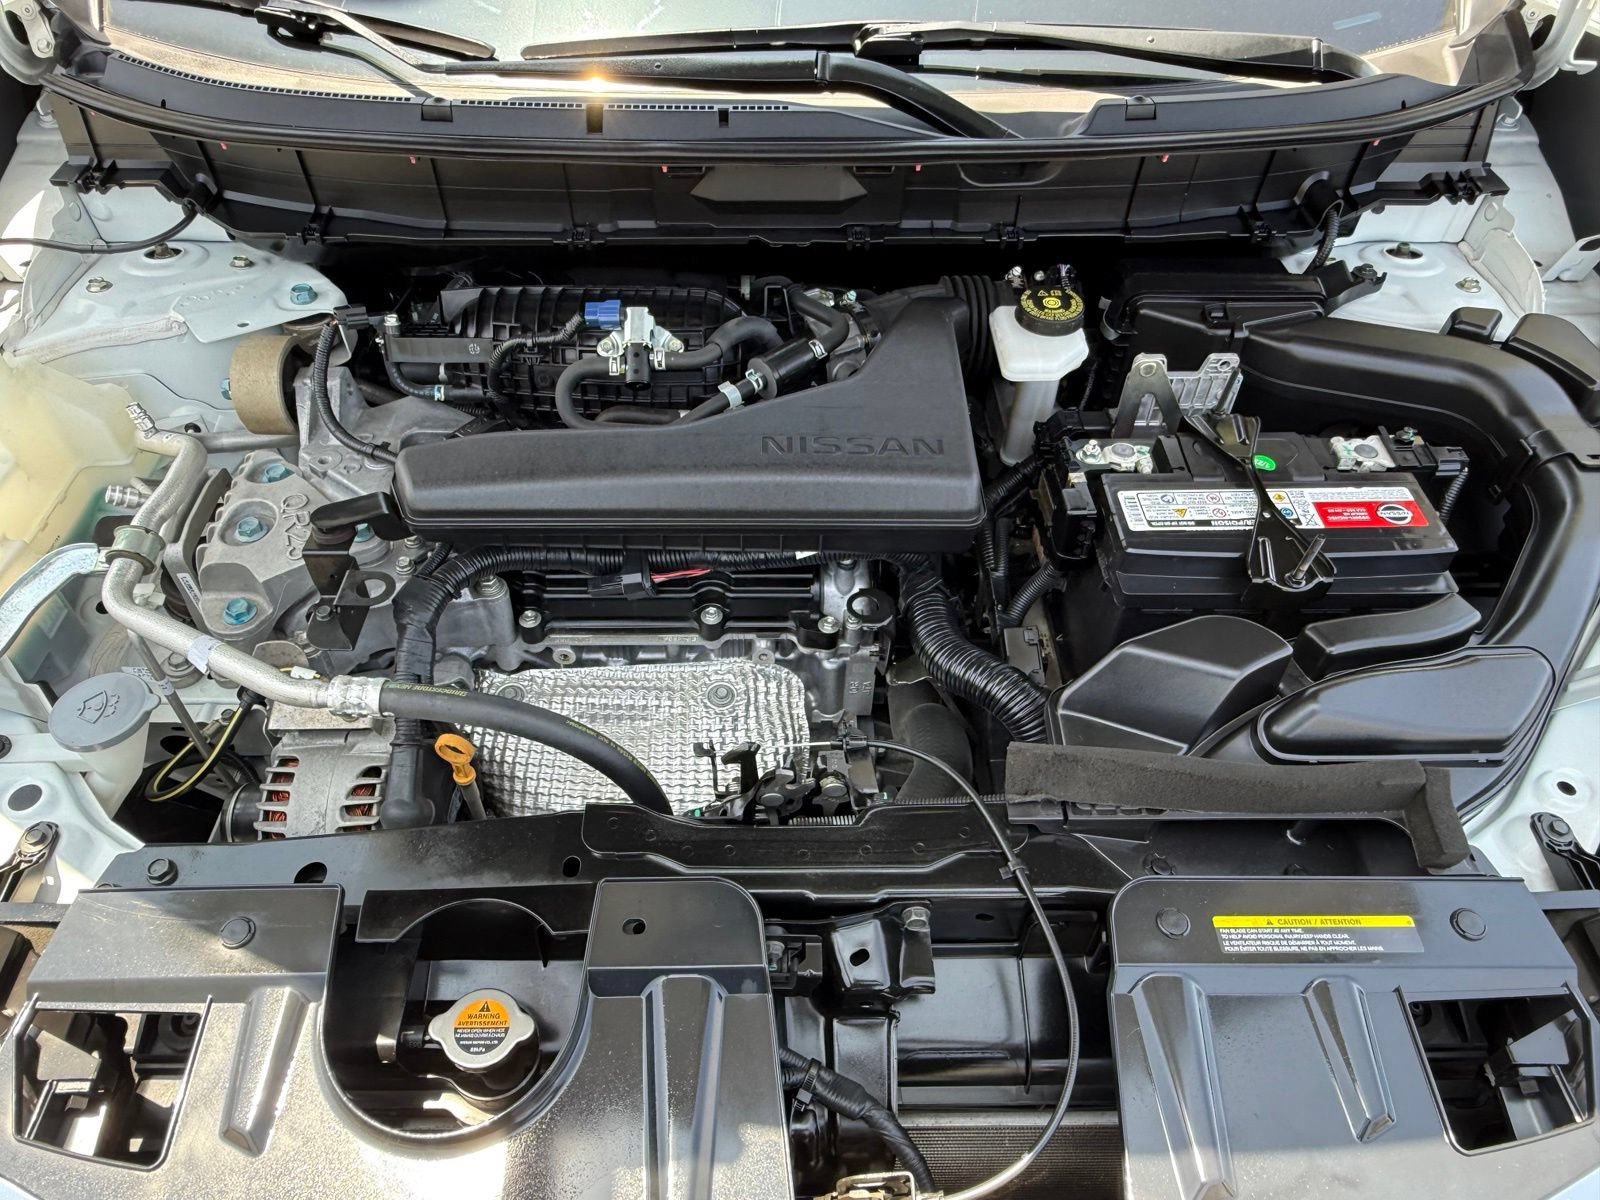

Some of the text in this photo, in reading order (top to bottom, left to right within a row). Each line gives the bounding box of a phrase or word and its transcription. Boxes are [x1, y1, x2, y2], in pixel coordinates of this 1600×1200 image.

[761, 436, 945, 456] NISSAN
[1277, 918, 1312, 926] CAUTION
[1320, 918, 1362, 926] ATTENTION
[467, 1012, 501, 1020] WARNING
